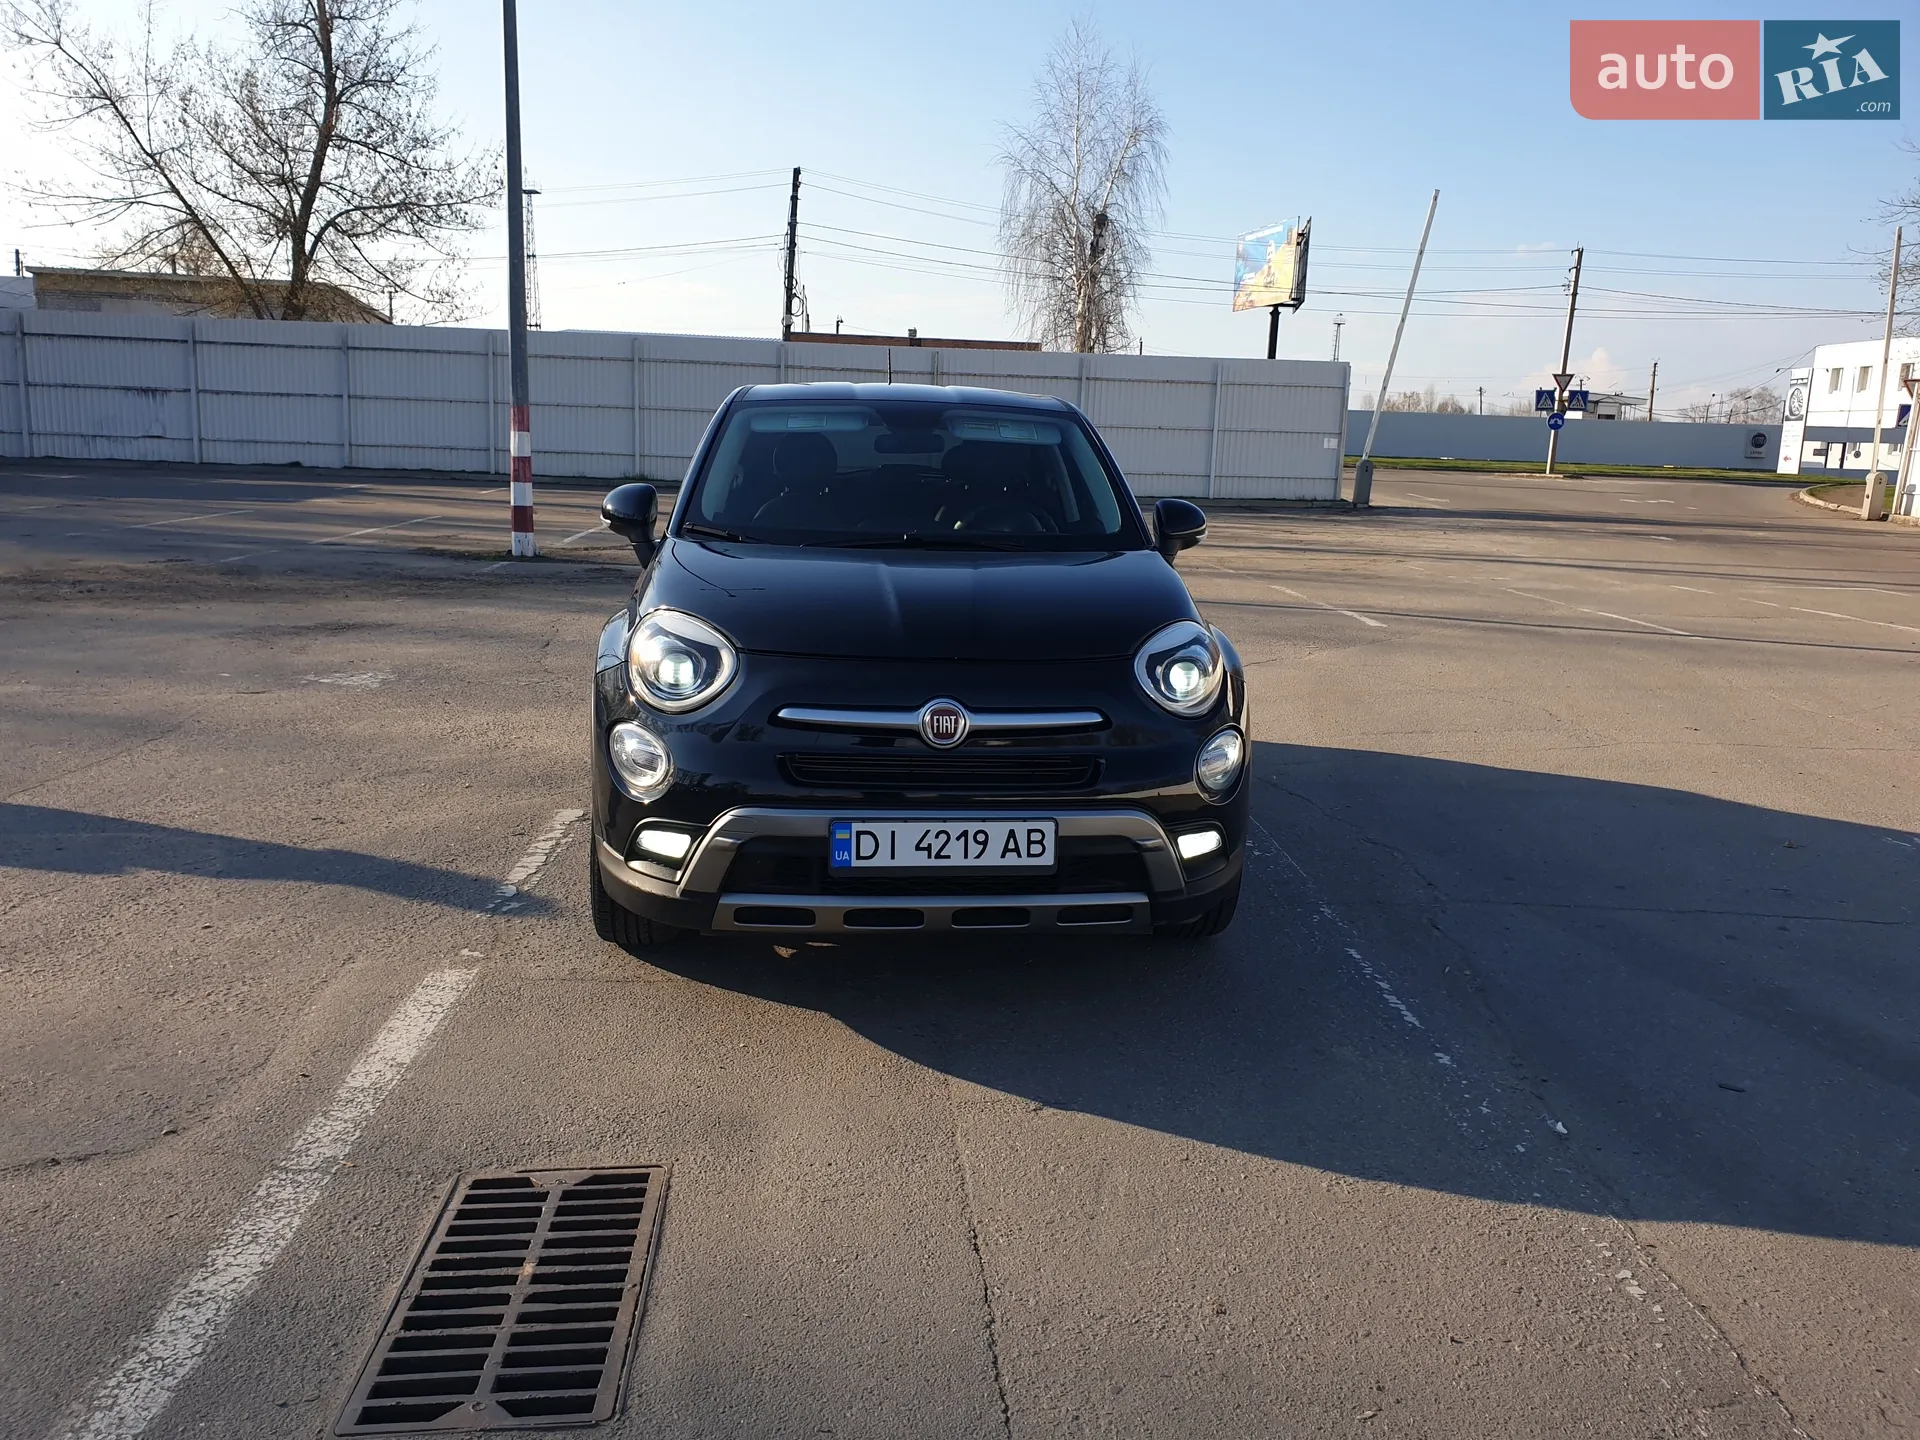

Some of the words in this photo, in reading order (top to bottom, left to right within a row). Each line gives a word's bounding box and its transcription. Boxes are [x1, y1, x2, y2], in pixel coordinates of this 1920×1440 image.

[933, 715, 957, 733] FIAT
[855, 830, 896, 860] DI
[914, 829, 990, 860] 4219
[1000, 828, 1047, 859] AB
[835, 850, 850, 861] UA
